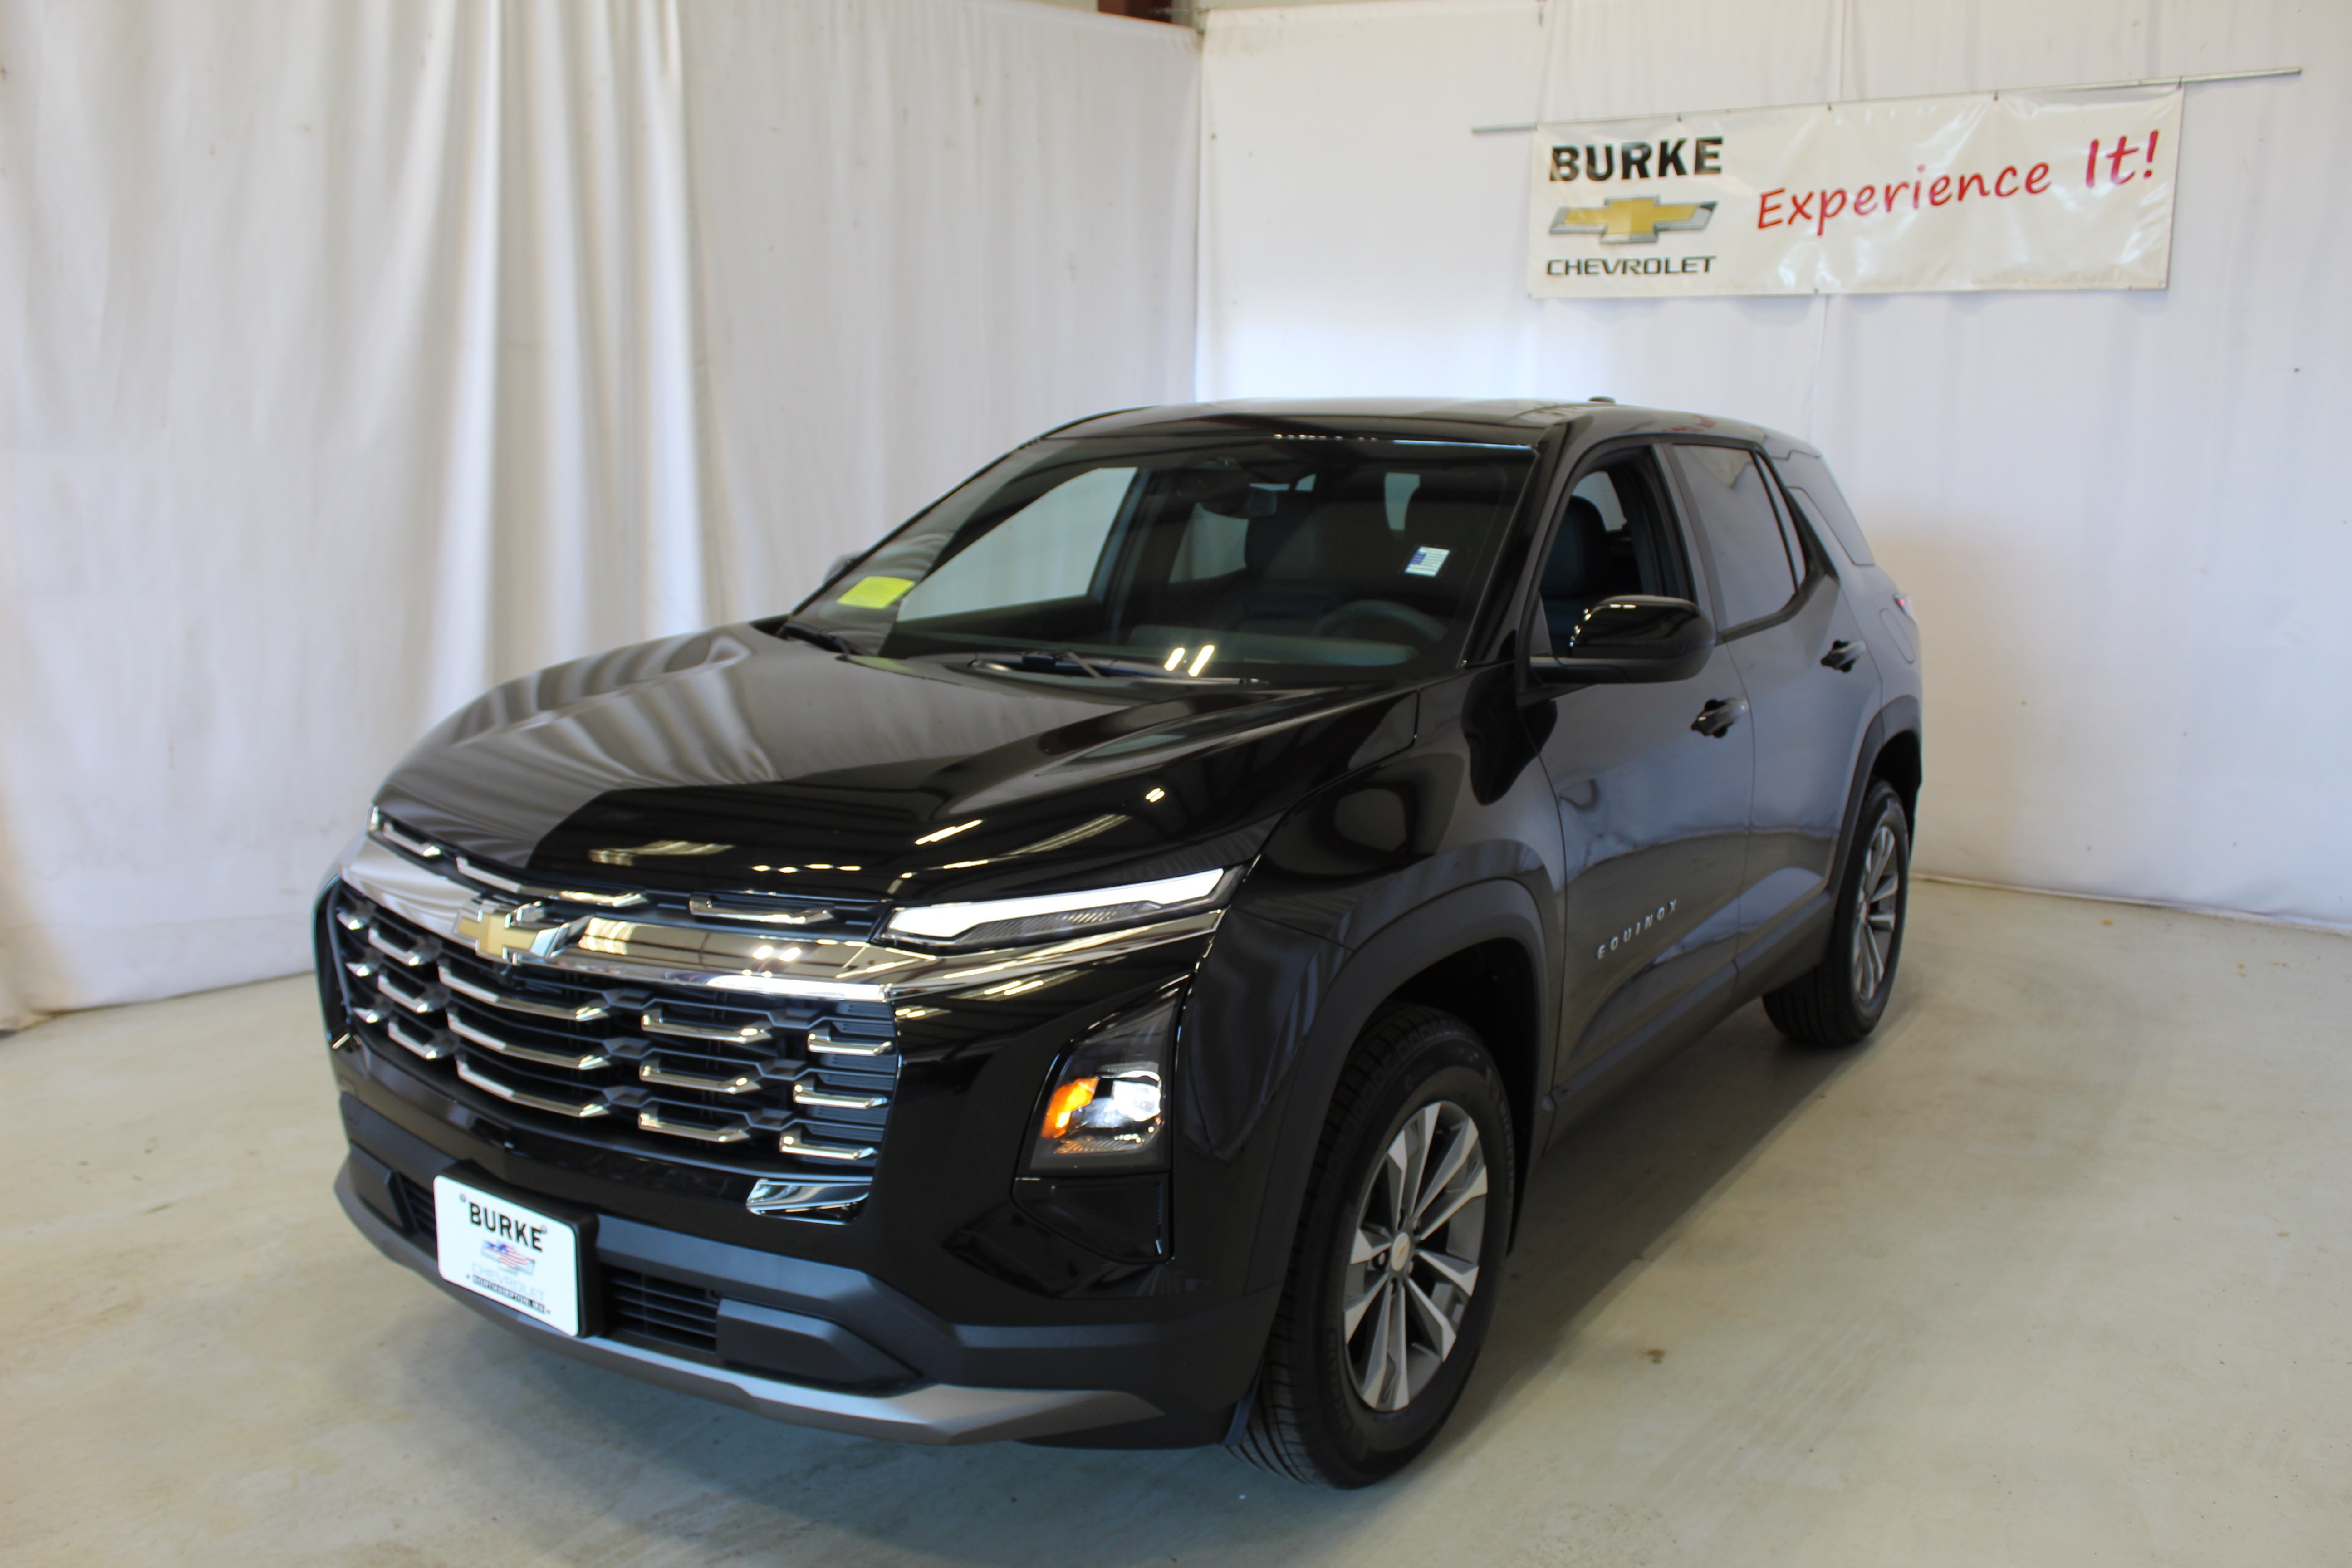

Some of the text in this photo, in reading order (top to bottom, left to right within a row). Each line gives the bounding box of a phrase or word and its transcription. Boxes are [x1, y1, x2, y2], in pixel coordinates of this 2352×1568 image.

[1549, 137, 1722, 181] BURKE
[1757, 130, 2158, 236] Experience It!
[1547, 256, 1716, 275] CHEVROLET
[1597, 899, 1676, 959] EQUINOX
[469, 1202, 543, 1251] BURKE
